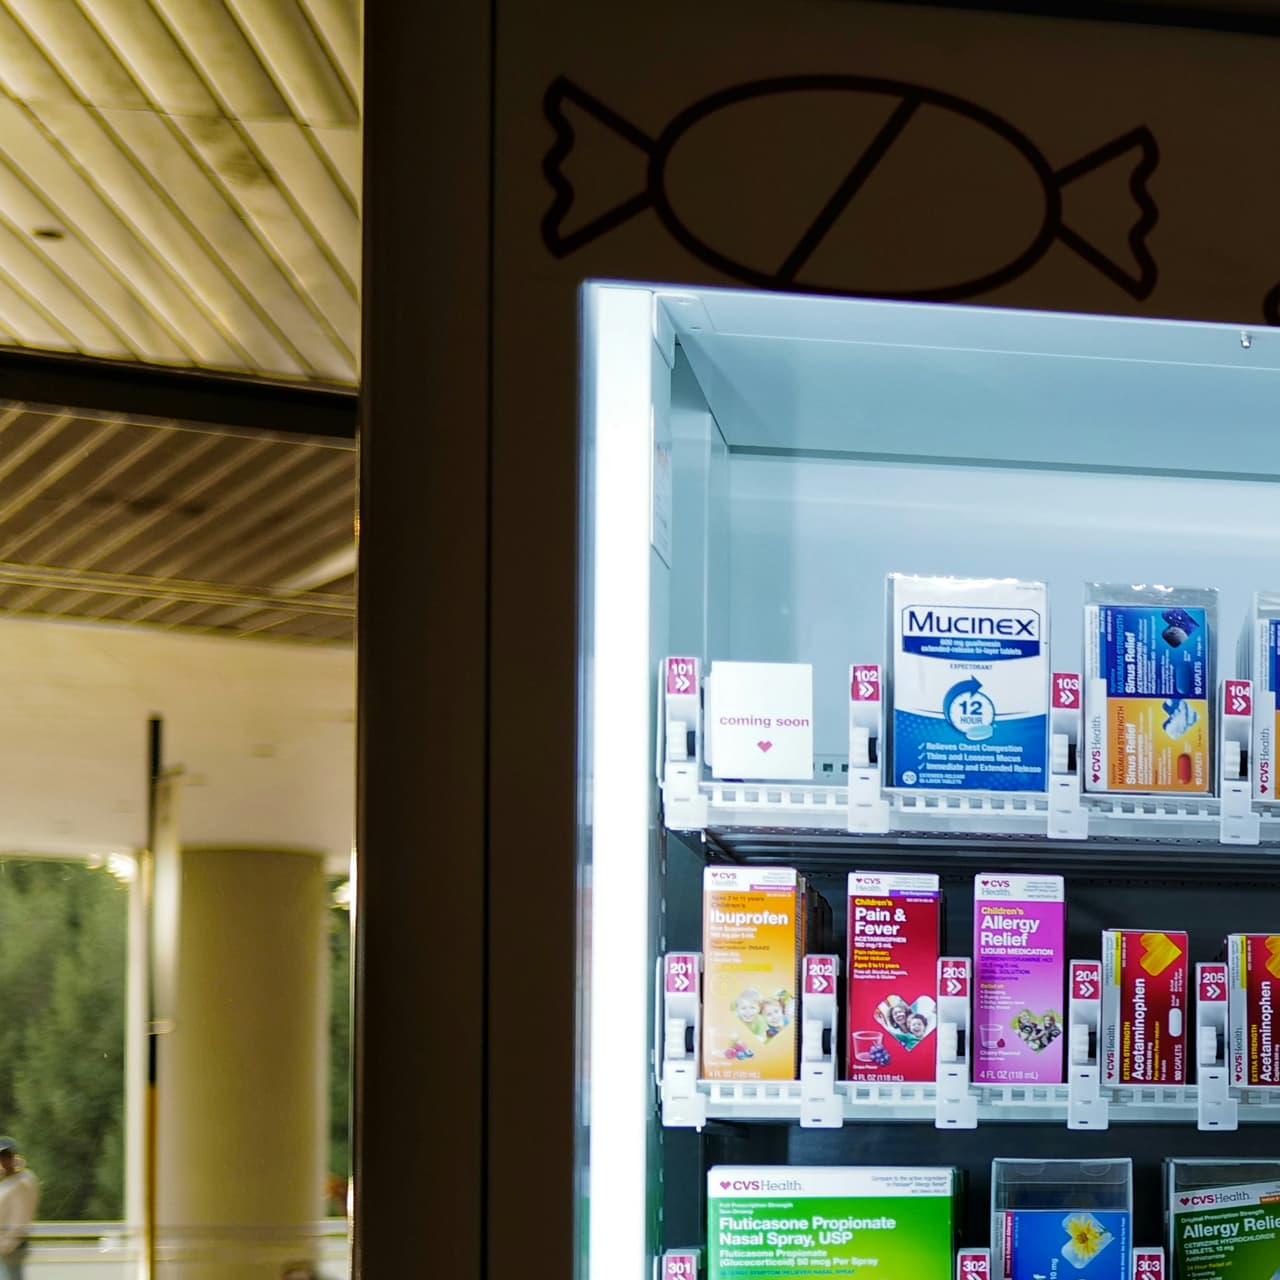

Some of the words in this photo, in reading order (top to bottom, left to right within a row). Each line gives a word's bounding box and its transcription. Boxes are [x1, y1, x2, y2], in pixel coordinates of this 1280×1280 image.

[909, 611, 1034, 636] Mucinex
[671, 663, 693, 674] 101
[1229, 686, 1250, 698] 104
[959, 701, 982, 716] 12
[720, 715, 771, 729] coming
[776, 717, 810, 727] soon
[710, 910, 788, 926] Ibuprofen
[855, 908, 891, 921] Pain
[894, 909, 906, 921] &
[855, 922, 900, 937] Fever
[981, 916, 1040, 933] Allergy
[981, 931, 1028, 947] Relief
[670, 963, 692, 974] 201
[943, 967, 966, 978] 203
[1202, 972, 1225, 983] 205
[1131, 978, 1145, 1081] Acetaminophen
[720, 1216, 808, 1230] Fluticasone
[813, 1216, 896, 1233] Propionate
[1183, 1220, 1240, 1242] Allergy
[720, 1233, 763, 1246] Nasal
[767, 1233, 815, 1249] Spray,
[819, 1233, 852, 1244] USP
[668, 1263, 690, 1273] 301
[963, 1261, 986, 1271] 302
